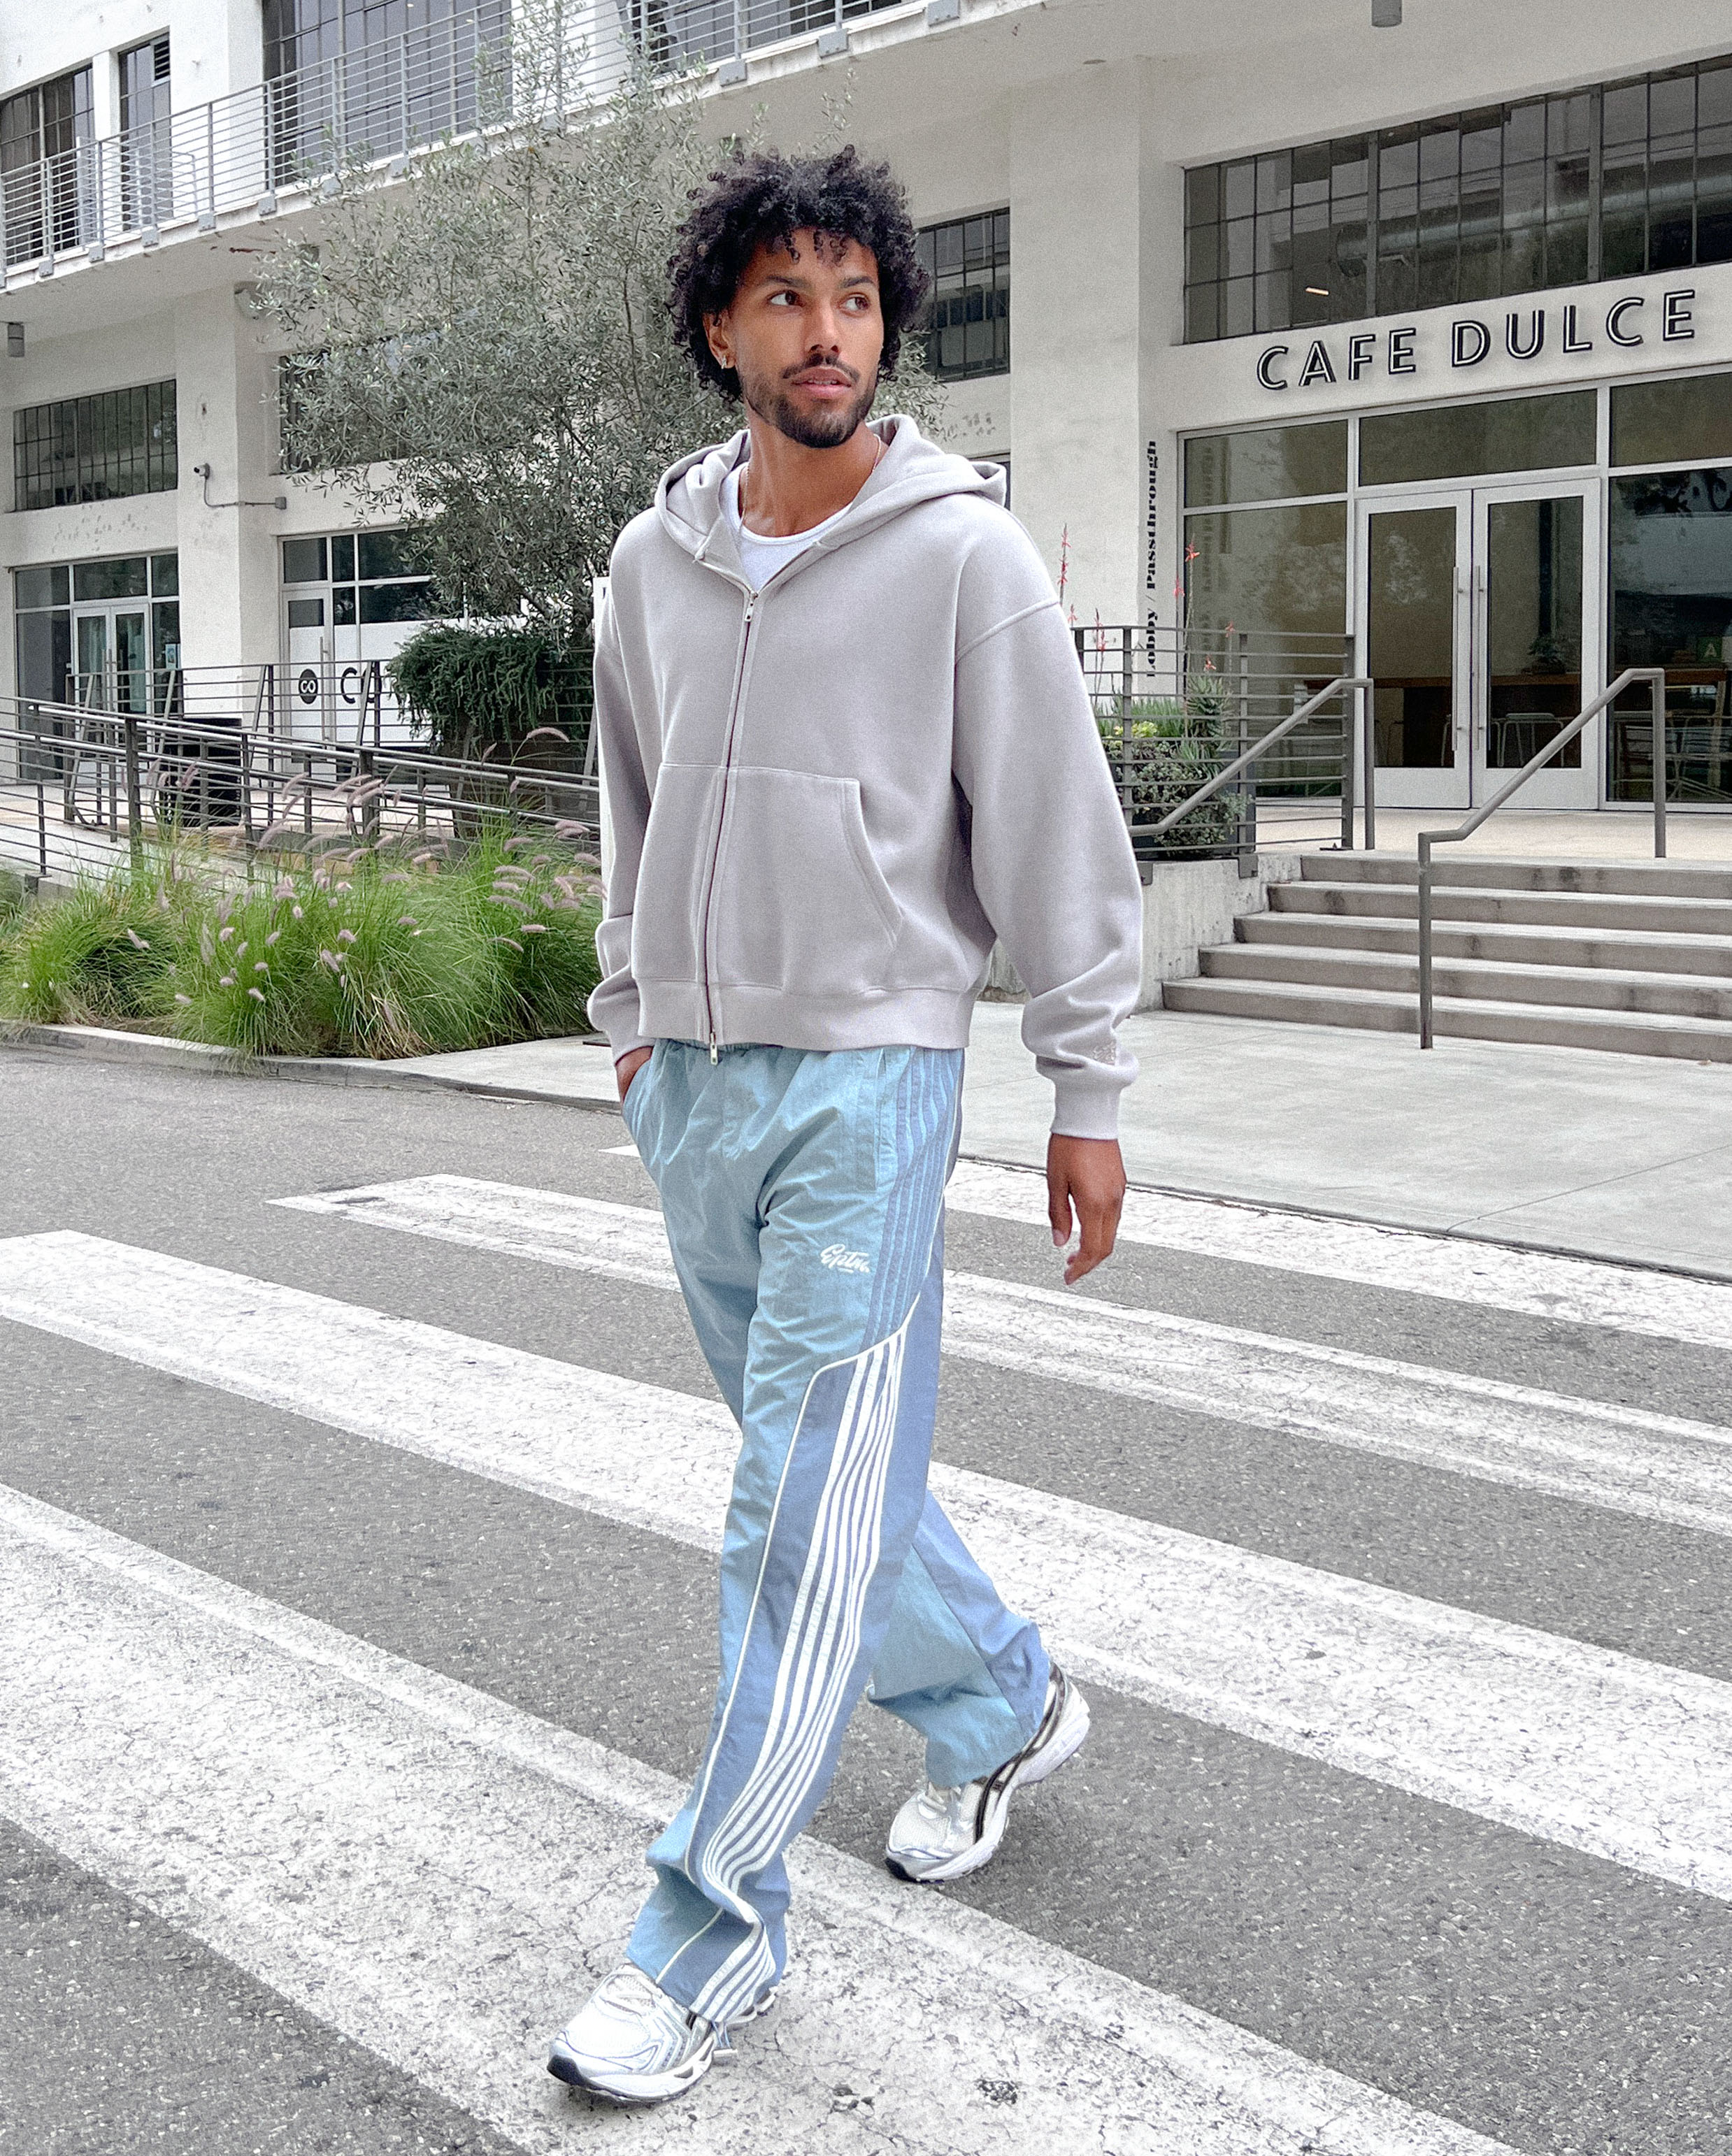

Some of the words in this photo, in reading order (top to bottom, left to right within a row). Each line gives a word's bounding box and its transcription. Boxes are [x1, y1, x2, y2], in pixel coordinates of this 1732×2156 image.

[1257, 327, 1417, 391] CAFE
[1451, 289, 1696, 368] DULCE
[1146, 440, 1158, 589] Passthrough
[1704, 642, 1718, 658] A
